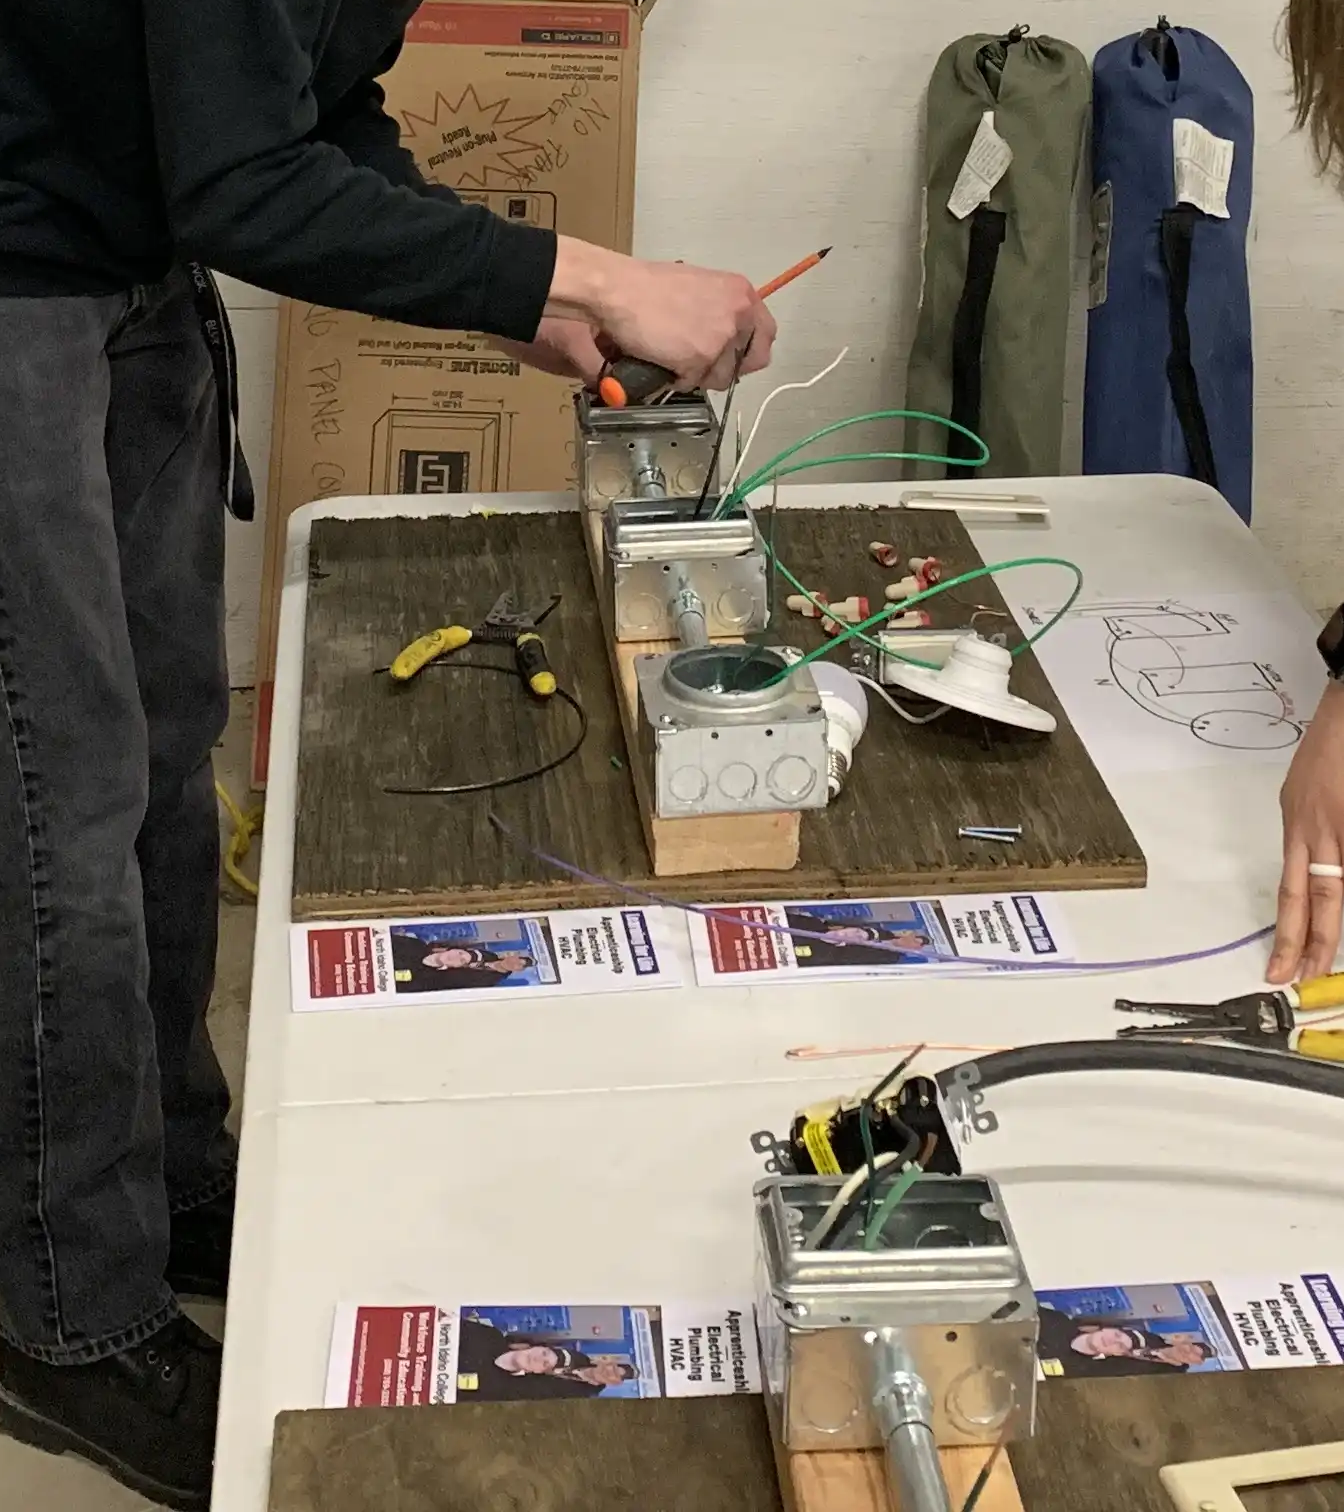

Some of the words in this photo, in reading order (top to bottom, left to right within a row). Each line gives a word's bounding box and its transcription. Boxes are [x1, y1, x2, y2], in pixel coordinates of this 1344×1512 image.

[442, 126, 471, 145] Ready
[573, 98, 610, 136] NO
[306, 358, 344, 444] PANEL
[1233, 1312, 1259, 1346] HVAC
[1247, 1301, 1280, 1356] Plumbing
[1265, 1299, 1303, 1355] Electrical
[1279, 1282, 1331, 1363] Apprenticeshi
[670, 1338, 685, 1371] HVAC
[687, 1327, 704, 1381] Plumbing
[707, 1326, 725, 1382] Electrical
[725, 1310, 750, 1391] Apprenticeshi
